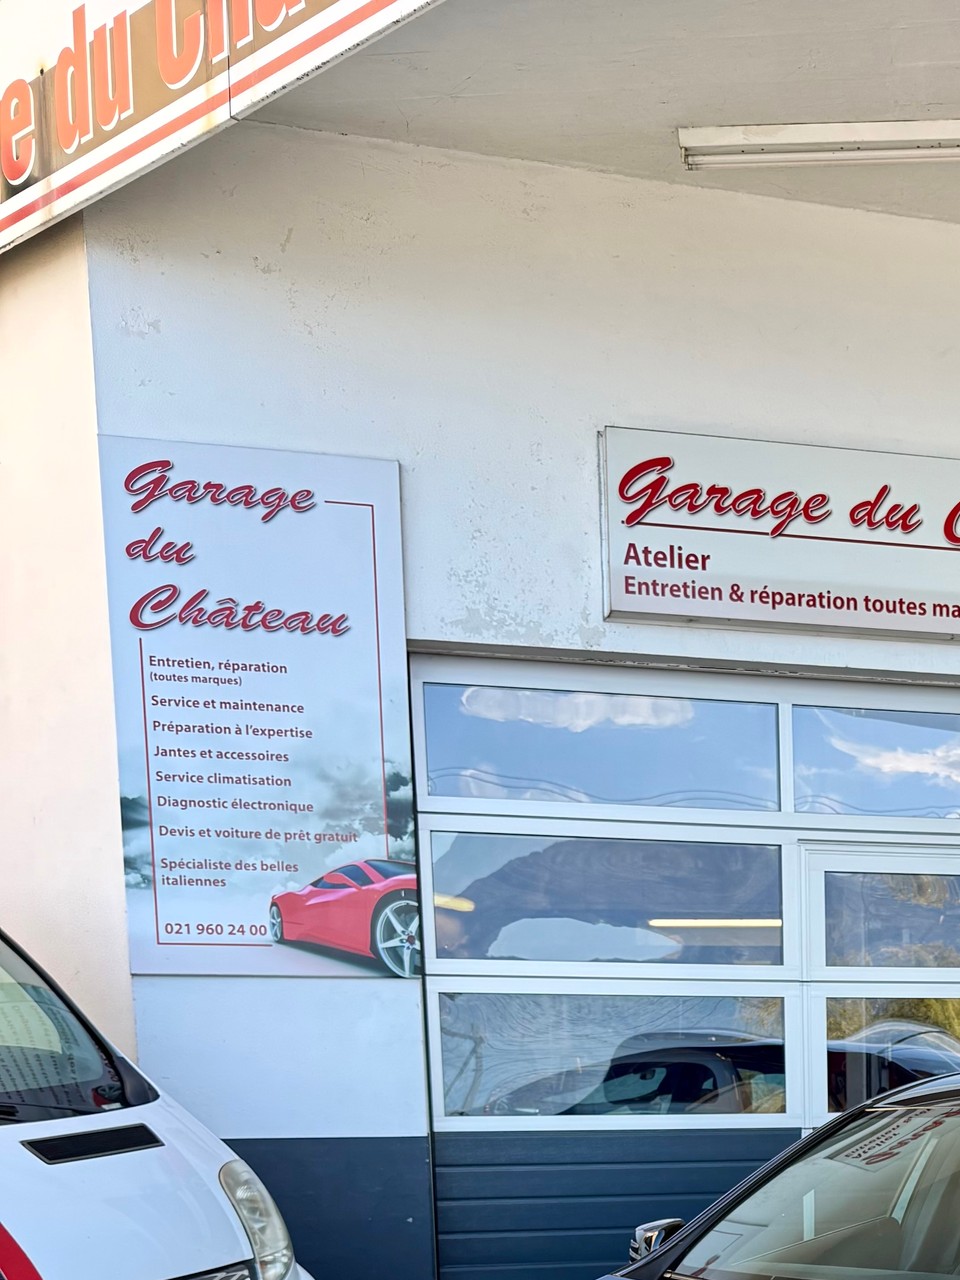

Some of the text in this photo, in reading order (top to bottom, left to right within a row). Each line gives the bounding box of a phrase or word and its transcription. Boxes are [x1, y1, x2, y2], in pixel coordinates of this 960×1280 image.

[54, 3, 133, 154] du
[123, 459, 317, 522] Garage
[618, 455, 832, 538] Garage
[849, 484, 923, 533] du
[124, 526, 196, 565] du
[623, 542, 711, 571] Atelier
[623, 575, 724, 602] Entretien
[728, 583, 745, 603] &
[749, 585, 859, 611] réparation
[863, 595, 927, 617] toutes
[128, 583, 351, 636] Château
[148, 655, 288, 676] Entretien, réparation
[149, 671, 243, 687] (toutes marques)
[151, 695, 305, 714] Service et maintenance
[152, 720, 231, 738] Préparation
[234, 724, 242, 735] à
[154, 745, 289, 763] Jantes et accessoires
[155, 770, 292, 787] Service climatisation
[157, 795, 314, 814] Diagnostic électronique
[158, 825, 358, 844] Devis et voiture de prêt gratuit
[160, 857, 299, 874] Spécialiste des belles
[161, 874, 226, 888] italiennes
[164, 922, 268, 937] 021 960 24 00
